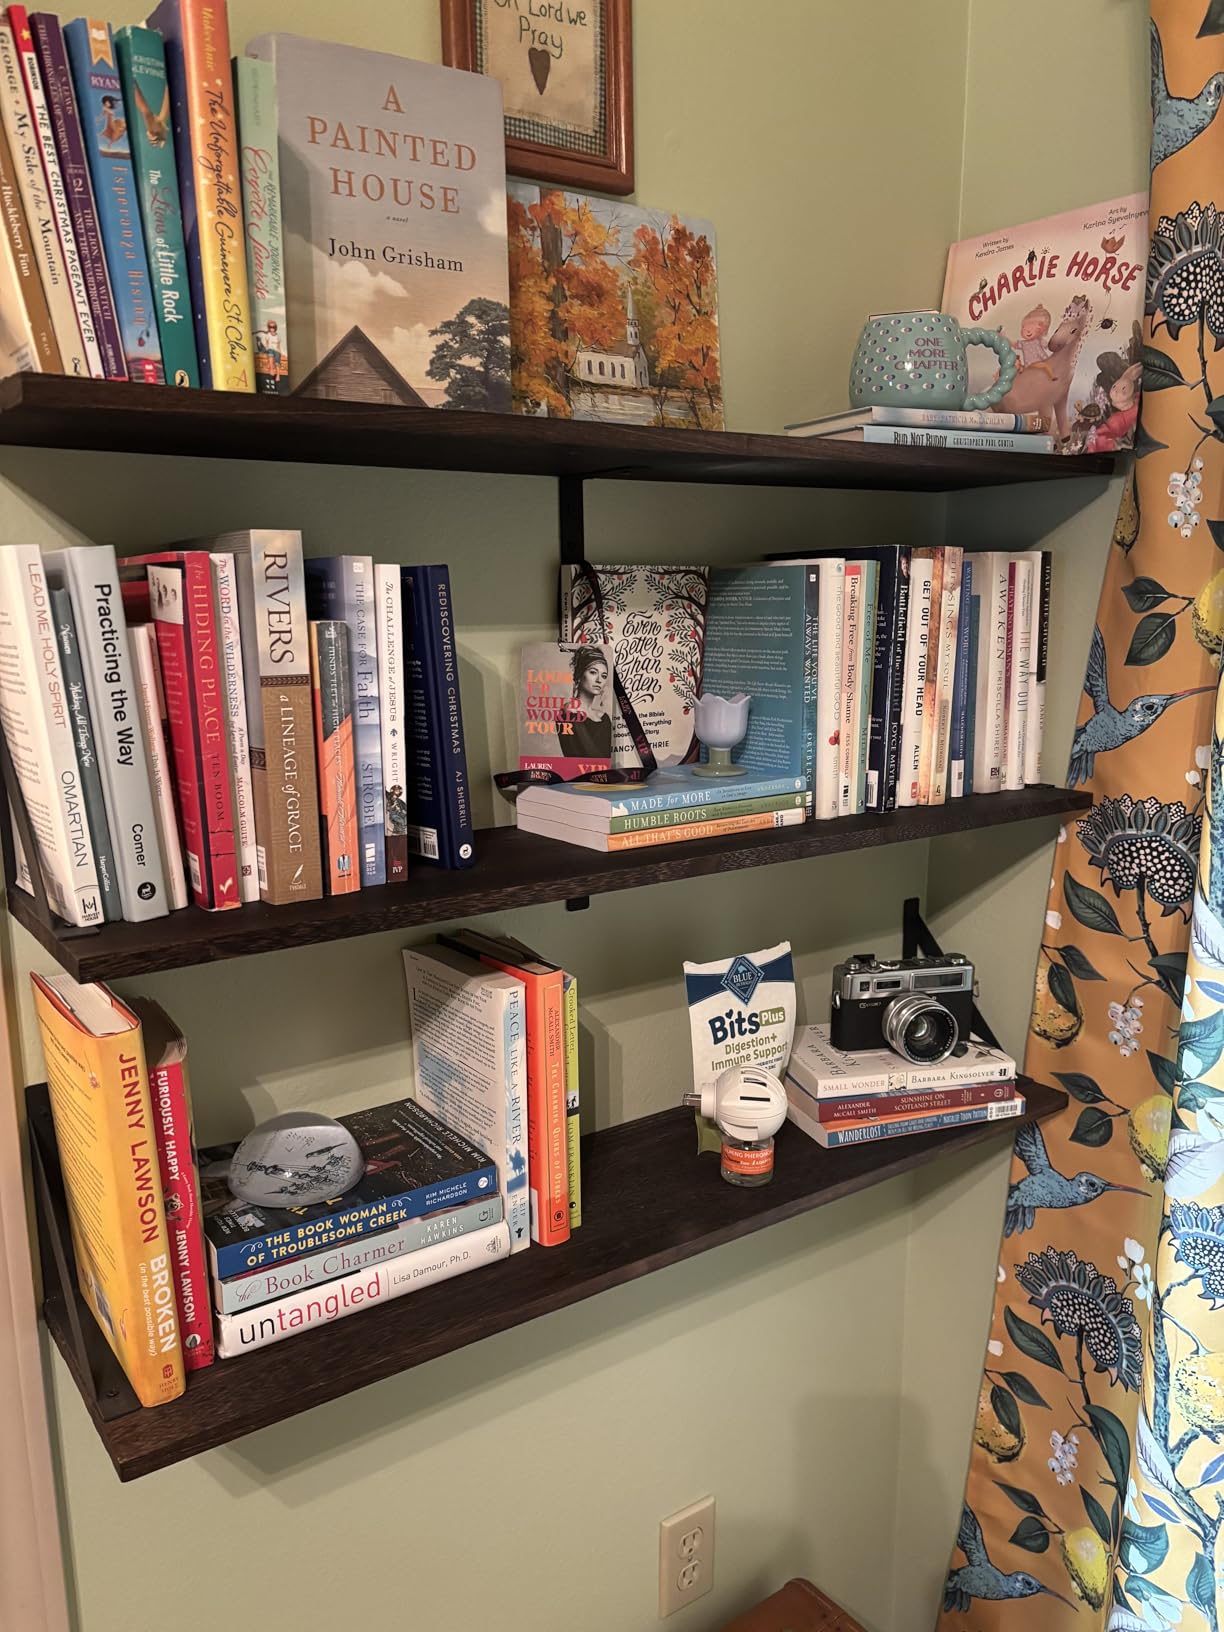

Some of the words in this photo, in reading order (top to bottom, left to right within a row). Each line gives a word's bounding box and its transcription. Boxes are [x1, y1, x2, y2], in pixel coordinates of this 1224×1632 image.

[528, 0, 563, 22] Lord
[567, 8, 587, 26] we
[519, 15, 563, 60] Pray
[27, 57, 40, 91] ROBINSON
[91, 76, 120, 90] RYAN
[132, 66, 166, 79] LEVINE
[381, 85, 405, 114] A
[36, 104, 49, 129] THE
[42, 135, 57, 166] BEST
[306, 115, 477, 171] PAINTED
[149, 169, 161, 184] The
[328, 167, 460, 214] HOUSE
[50, 171, 74, 244] CHRISTMAS
[151, 185, 177, 235] Lions
[2, 186, 24, 250] Huckleberry
[18, 253, 31, 278] Finn
[155, 238, 170, 250] of
[982, 239, 1002, 249] Written
[1002, 236, 1009, 246] by
[328, 237, 376, 261] John
[382, 245, 464, 272] Grisham
[975, 248, 996, 259] Kendra
[995, 243, 1015, 254] James
[66, 249, 87, 306] PAGEANT
[157, 251, 179, 286] Little
[968, 255, 1060, 321] CHARLIE
[1065, 250, 1144, 292] HORSE
[162, 290, 184, 324] Rock
[79, 310, 95, 343] EVER
[914, 337, 944, 347] ONE
[894, 359, 959, 371] CHAPTER
[908, 348, 950, 359] MORE
[28, 563, 46, 607] LEAD
[355, 583, 365, 606] THE
[847, 576, 859, 621] Breaking
[922, 580, 932, 600] GET
[36, 609, 49, 635] ME
[263, 551, 295, 664] RIVERS
[920, 607, 930, 628] OUT
[996, 574, 1008, 660] AWAKEN
[60, 623, 74, 655] Nouwen
[94, 584, 122, 683] Practicing
[356, 610, 367, 640] CASE
[804, 614, 813, 656] ALWAYS
[848, 624, 857, 645] Free
[358, 643, 368, 666] FOR
[847, 647, 855, 662] from
[919, 634, 928, 648] OF
[1019, 631, 1031, 652] THE
[1041, 621, 1049, 667] CHURCH
[40, 637, 57, 678] HOLY
[438, 583, 455, 682] REDISCOVERING
[447, 687, 461, 754] CHRISTMAS
[917, 654, 927, 681] YOUR
[1018, 659, 1030, 684] WAY
[526, 669, 574, 684] LOOK
[527, 683, 550, 696] UP
[804, 659, 812, 704] WANTED
[845, 664, 855, 691] Body
[48, 682, 68, 729] SPIRIT
[111, 689, 128, 722] the
[357, 671, 376, 719] Faith
[526, 696, 582, 710] CHILD
[844, 692, 855, 724] Shame
[915, 687, 925, 716] HEAD
[995, 670, 1004, 720] PRISCILLA
[1017, 691, 1029, 712] OUT
[525, 721, 575, 735] TOUR
[526, 709, 587, 723] WORLD
[642, 719, 672, 727] Everything
[116, 727, 135, 766] Way
[280, 706, 298, 780] LINEAGE
[890, 721, 899, 753] JOYCE
[993, 723, 1001, 759] SHIRER
[209, 753, 221, 778] TEN
[391, 743, 399, 782] WRIGHT
[524, 762, 553, 770] LAUREN
[805, 732, 813, 782] ORTBERG
[888, 754, 898, 787] MEYER
[912, 744, 920, 770] ALLEN
[281, 784, 295, 794] of
[455, 770, 462, 783] AJ
[213, 782, 225, 821] BOOM
[361, 763, 377, 828] STROBEL
[456, 786, 469, 829] SHERRILL
[631, 796, 664, 812] MADE
[666, 794, 679, 806] for
[682, 791, 711, 804] MORE
[61, 770, 89, 867] OMARTIAN
[286, 793, 303, 853] GRACE
[624, 812, 670, 830] HUMBLE
[673, 809, 707, 823] ROOTS
[131, 823, 146, 867] Comer
[621, 835, 643, 848] ALL
[645, 829, 682, 845] THAT'S
[683, 825, 714, 838] GOOD
[99, 855, 110, 892] HarperCollins
[732, 972, 753, 983] BLUE
[509, 990, 521, 1042] PEACE
[708, 1008, 761, 1045] Bits
[761, 1010, 785, 1025] Plus
[711, 1051, 752, 1072] Immune
[753, 1041, 788, 1060] Support
[724, 1032, 778, 1056] Digestion+
[510, 1049, 519, 1076] LIKE
[911, 1075, 946, 1084] BARBARA
[949, 1070, 995, 1080] KINGSOLVER
[119, 1053, 145, 1130] JENNY
[511, 1082, 518, 1090] A
[823, 1084, 849, 1092] SMALL
[851, 1080, 885, 1090] WONDER
[900, 1095, 934, 1104] SUNSHINE
[934, 1093, 945, 1101] ON
[156, 1070, 175, 1137] FURIOUSLY
[404, 1101, 444, 1132] RICHARDSON
[837, 1101, 871, 1111] ALEXANDER
[894, 1102, 928, 1112] SCOTLAND
[929, 1099, 952, 1107] STREET
[511, 1096, 522, 1144] RIVER
[567, 1121, 575, 1144] TOM
[838, 1126, 882, 1144] WANDERLOST
[444, 1130, 472, 1154] MICHELE
[471, 1151, 488, 1163] KIM
[165, 1140, 180, 1181] HAPPY
[567, 1147, 576, 1196] FRANKLIN
[130, 1140, 160, 1244] LAWSON
[425, 1191, 438, 1200] KIM
[438, 1182, 468, 1196] MICHELE
[425, 1188, 468, 1206] RICHARDSON
[246, 1254, 265, 1266] OF
[271, 1224, 363, 1259] TROUBLESOME
[369, 1208, 407, 1228] CREEK
[265, 1232, 291, 1248] THE
[297, 1218, 334, 1239] BOOK
[339, 1202, 388, 1224] WOMAN
[420, 1224, 464, 1245] HAWKINS
[426, 1216, 458, 1233] KAREN
[175, 1229, 190, 1267] JENNY
[235, 1279, 262, 1303] the
[266, 1265, 315, 1294] Book
[322, 1239, 406, 1275] Charmer
[393, 1271, 411, 1285] Lisa
[412, 1258, 448, 1279] Damour,
[449, 1251, 471, 1265] Ph.D.
[150, 1252, 177, 1354] BROKEN
[180, 1270, 196, 1324] LAWSON
[239, 1272, 381, 1345] untangled
